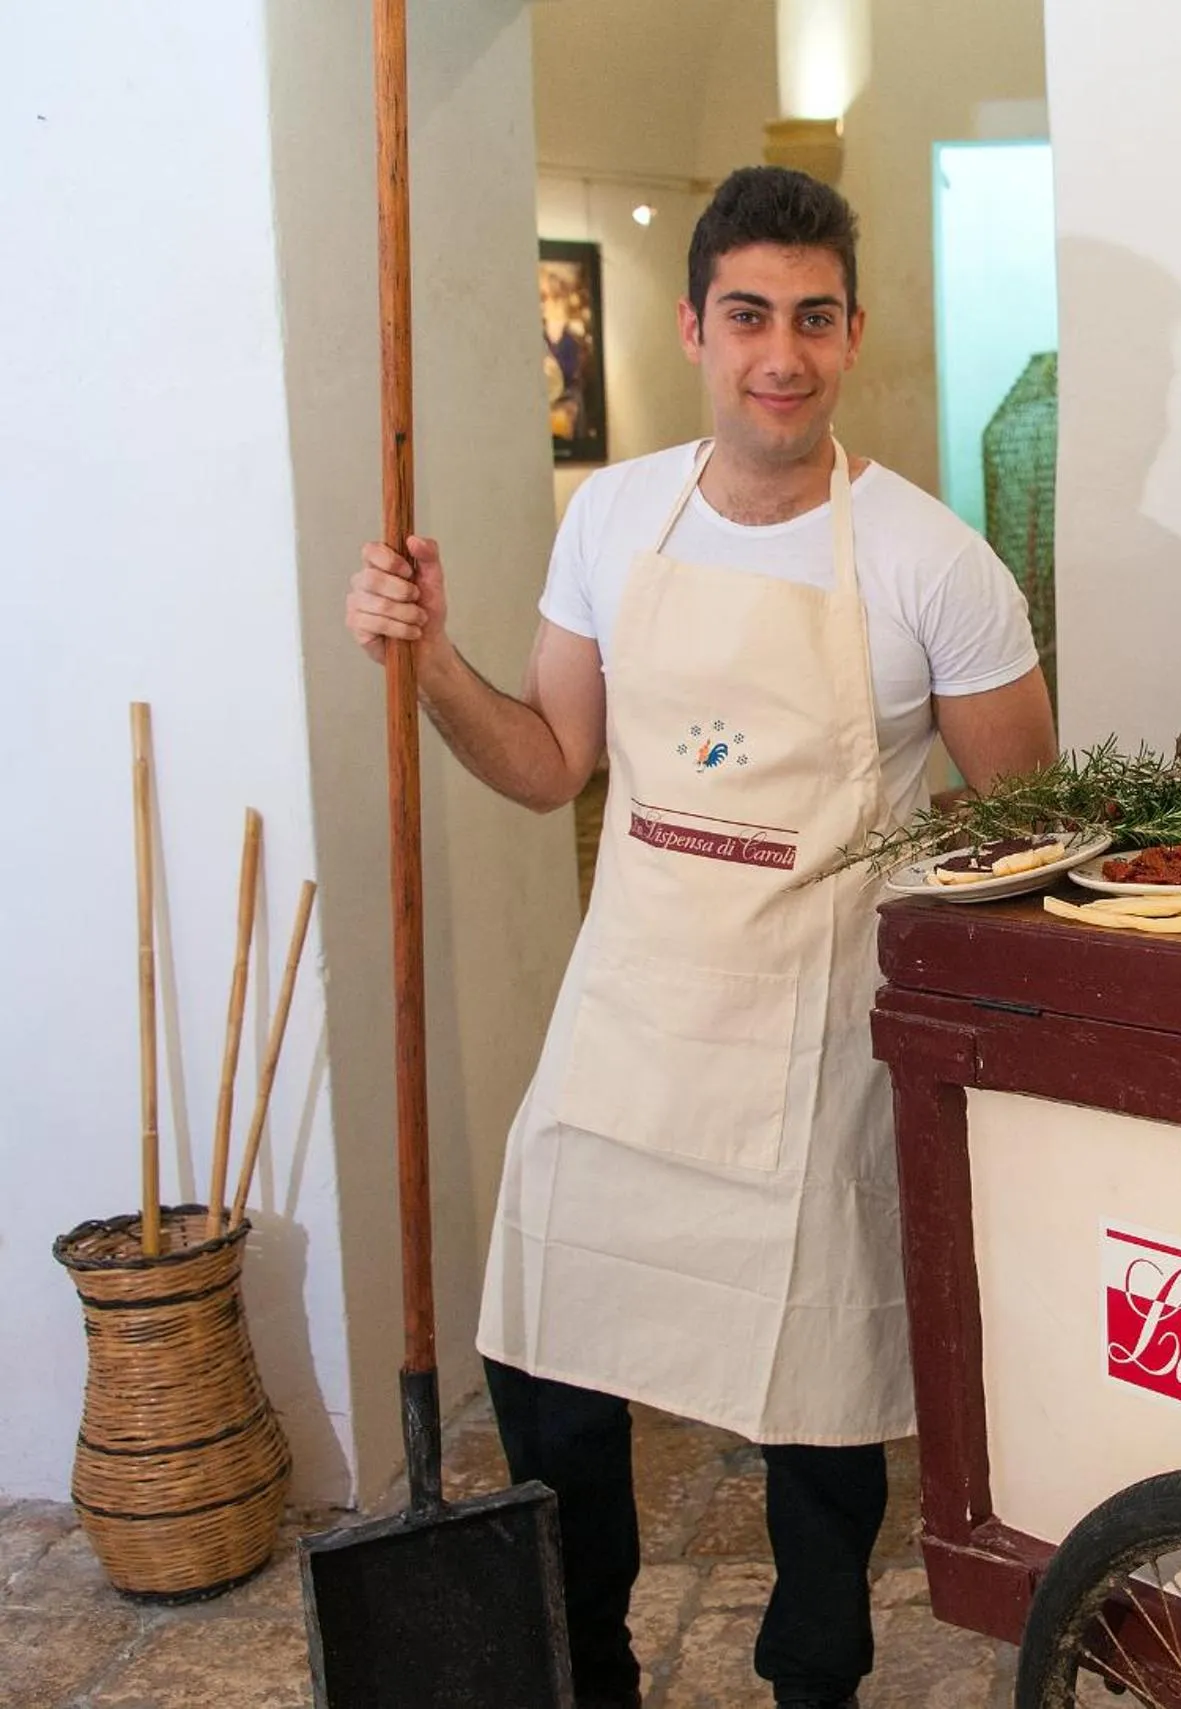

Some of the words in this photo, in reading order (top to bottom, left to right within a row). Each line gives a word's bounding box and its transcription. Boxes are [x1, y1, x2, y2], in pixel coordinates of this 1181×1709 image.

[643, 811, 715, 852] Dispensa
[716, 837, 736, 856] di
[739, 828, 795, 866] Caroli
